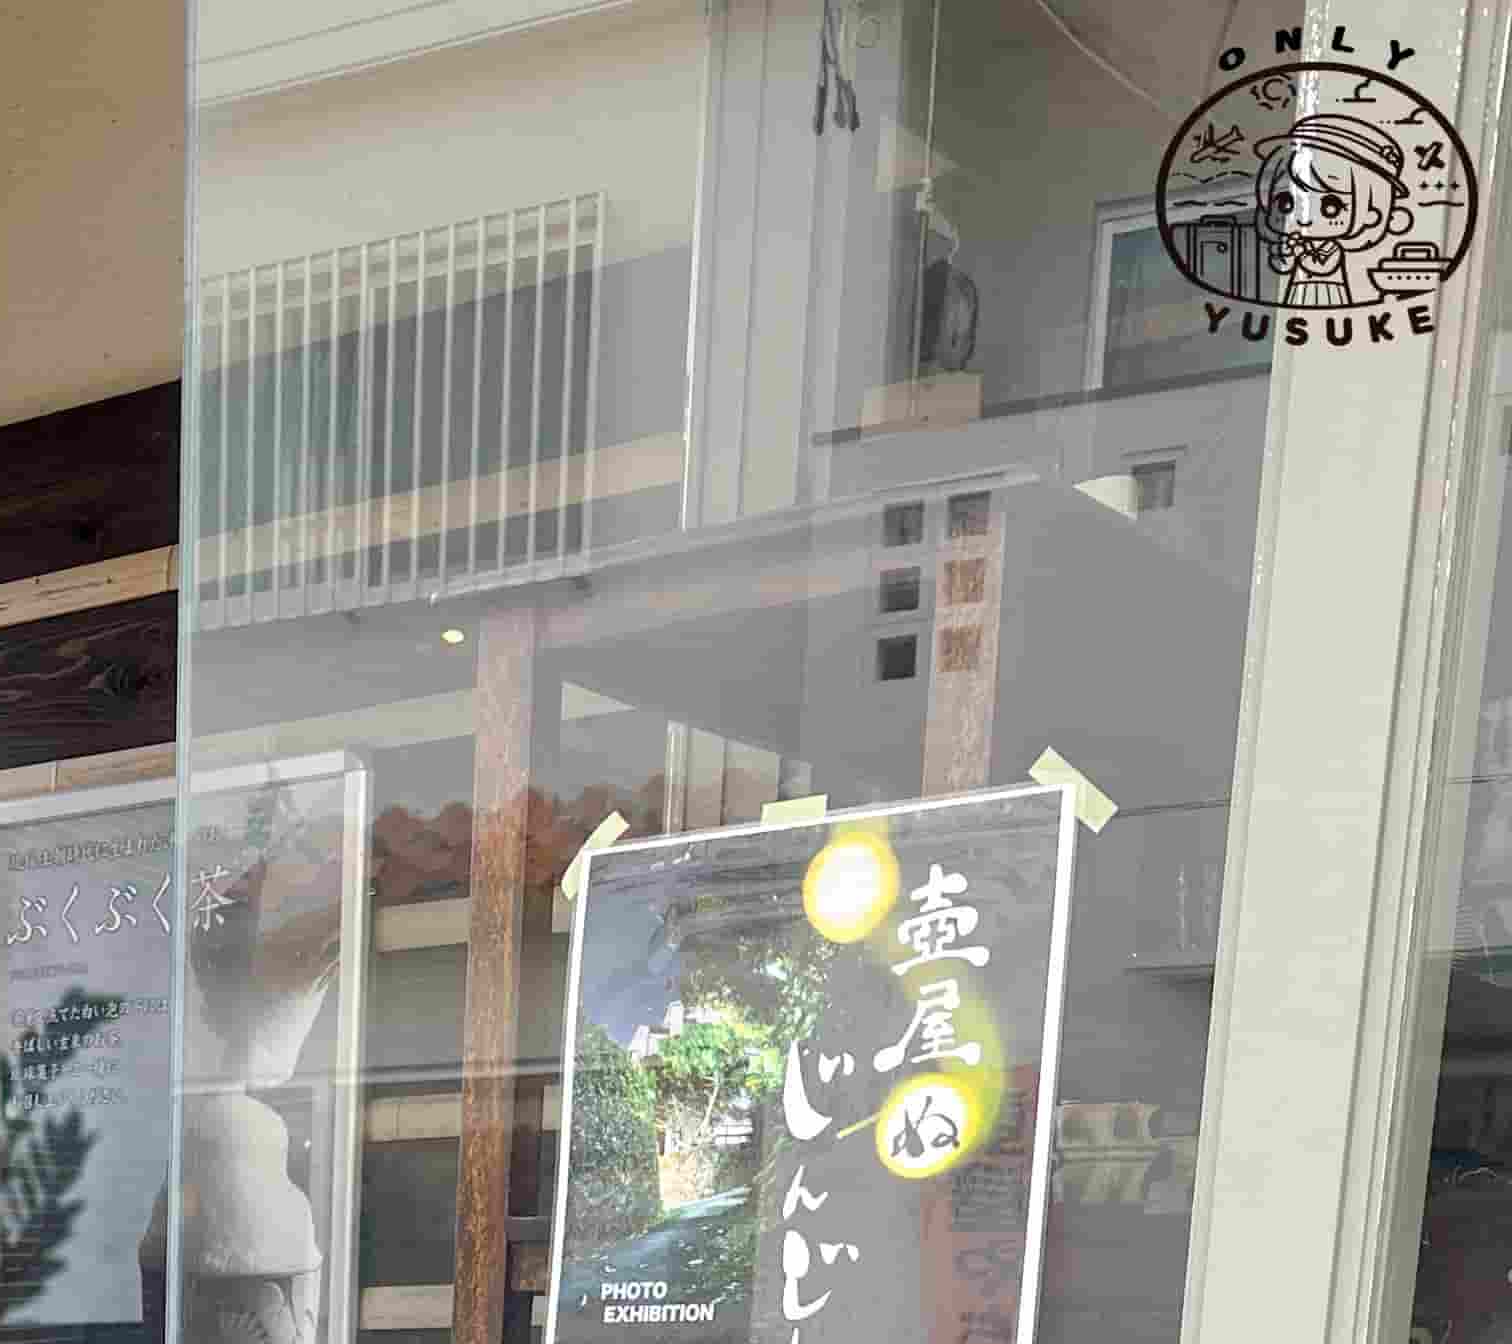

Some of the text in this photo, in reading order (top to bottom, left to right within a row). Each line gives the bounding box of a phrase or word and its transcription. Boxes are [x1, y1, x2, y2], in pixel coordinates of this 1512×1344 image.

[7, 864, 233, 945] ぶくぶく茶
[600, 1280, 668, 1300] PHOTO
[602, 1302, 715, 1323] EXHIBITION
